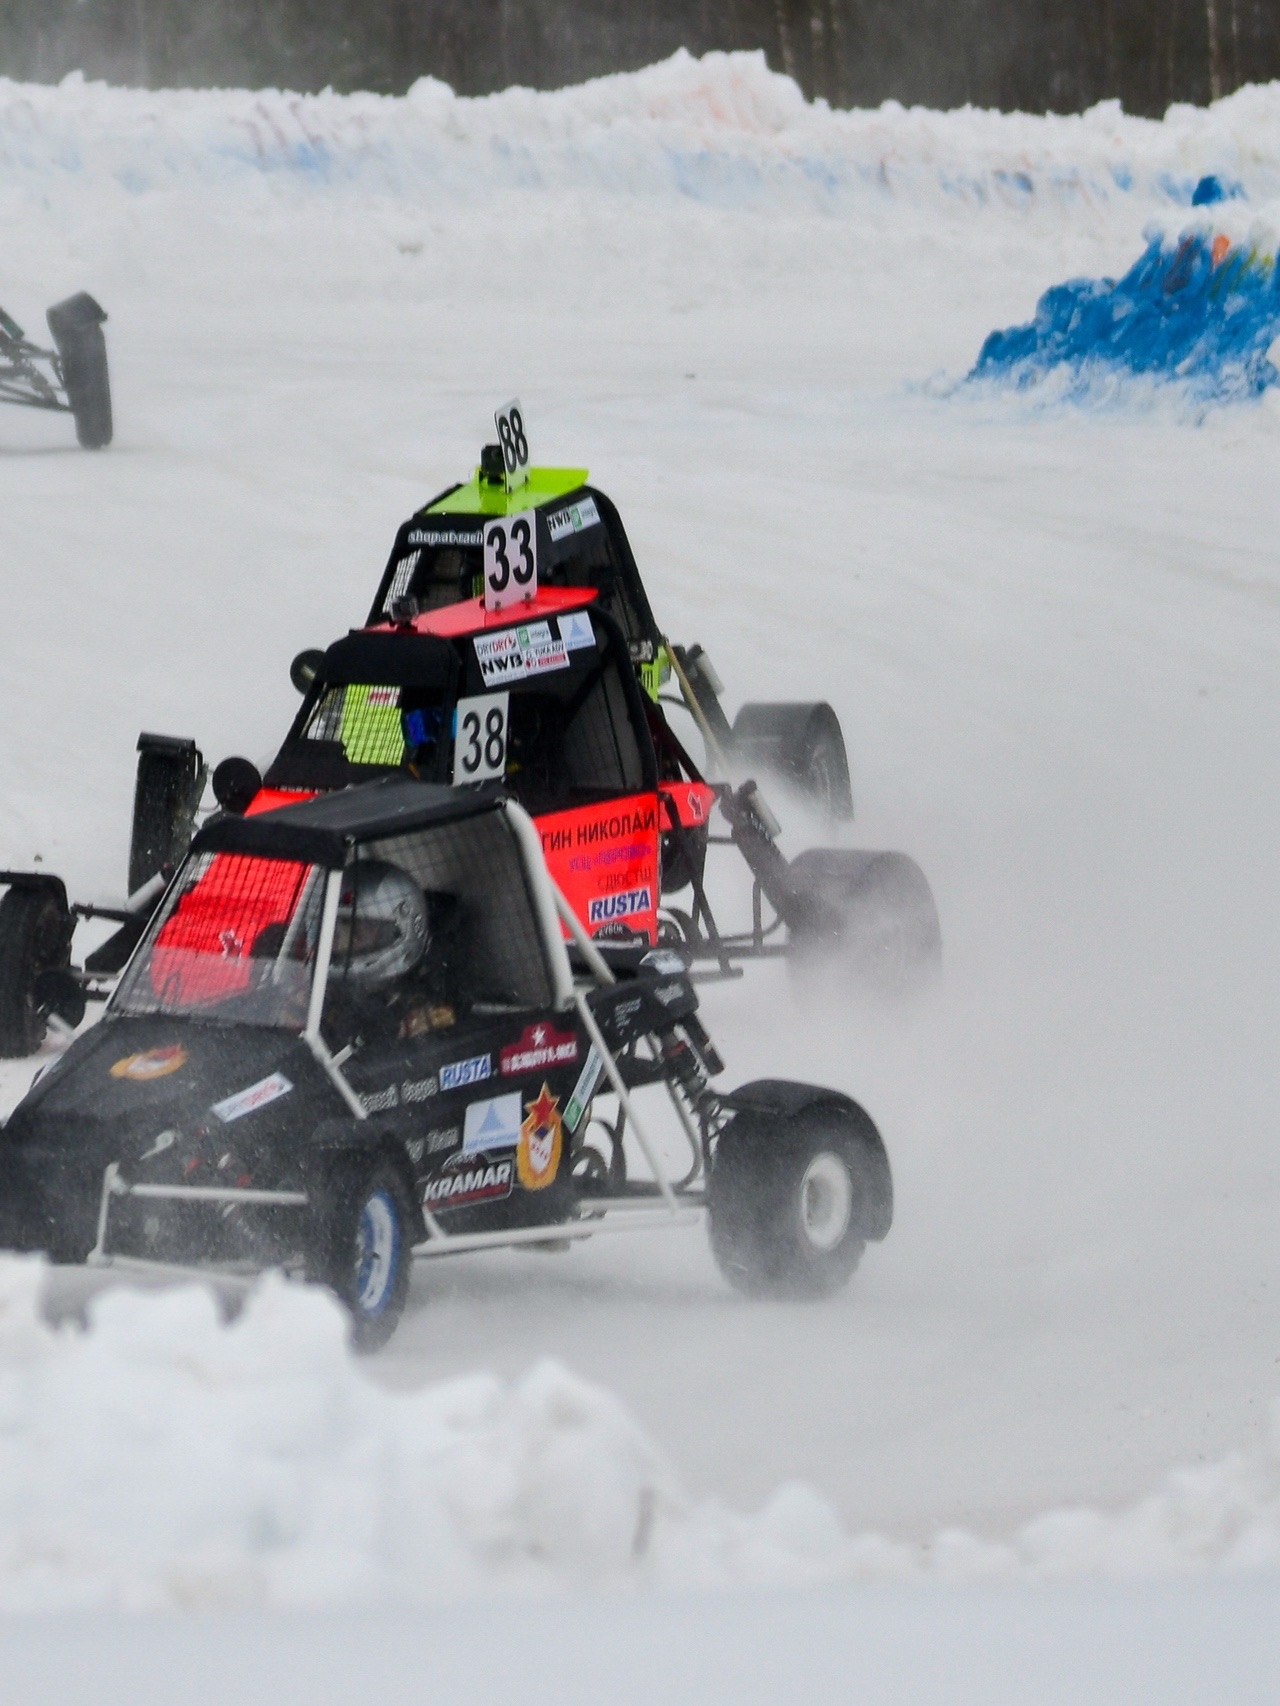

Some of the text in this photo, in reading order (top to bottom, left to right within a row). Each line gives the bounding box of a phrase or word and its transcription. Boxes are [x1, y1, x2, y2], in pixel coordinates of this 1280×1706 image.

[498, 408, 528, 474] 88
[487, 519, 535, 592] 33
[481, 653, 523, 676] NWB
[462, 707, 505, 773] 38
[541, 828, 572, 854] ГИН
[591, 889, 650, 922] RUSTA
[442, 1057, 490, 1088] RUSTA
[424, 1163, 511, 1201] KRAMAR
